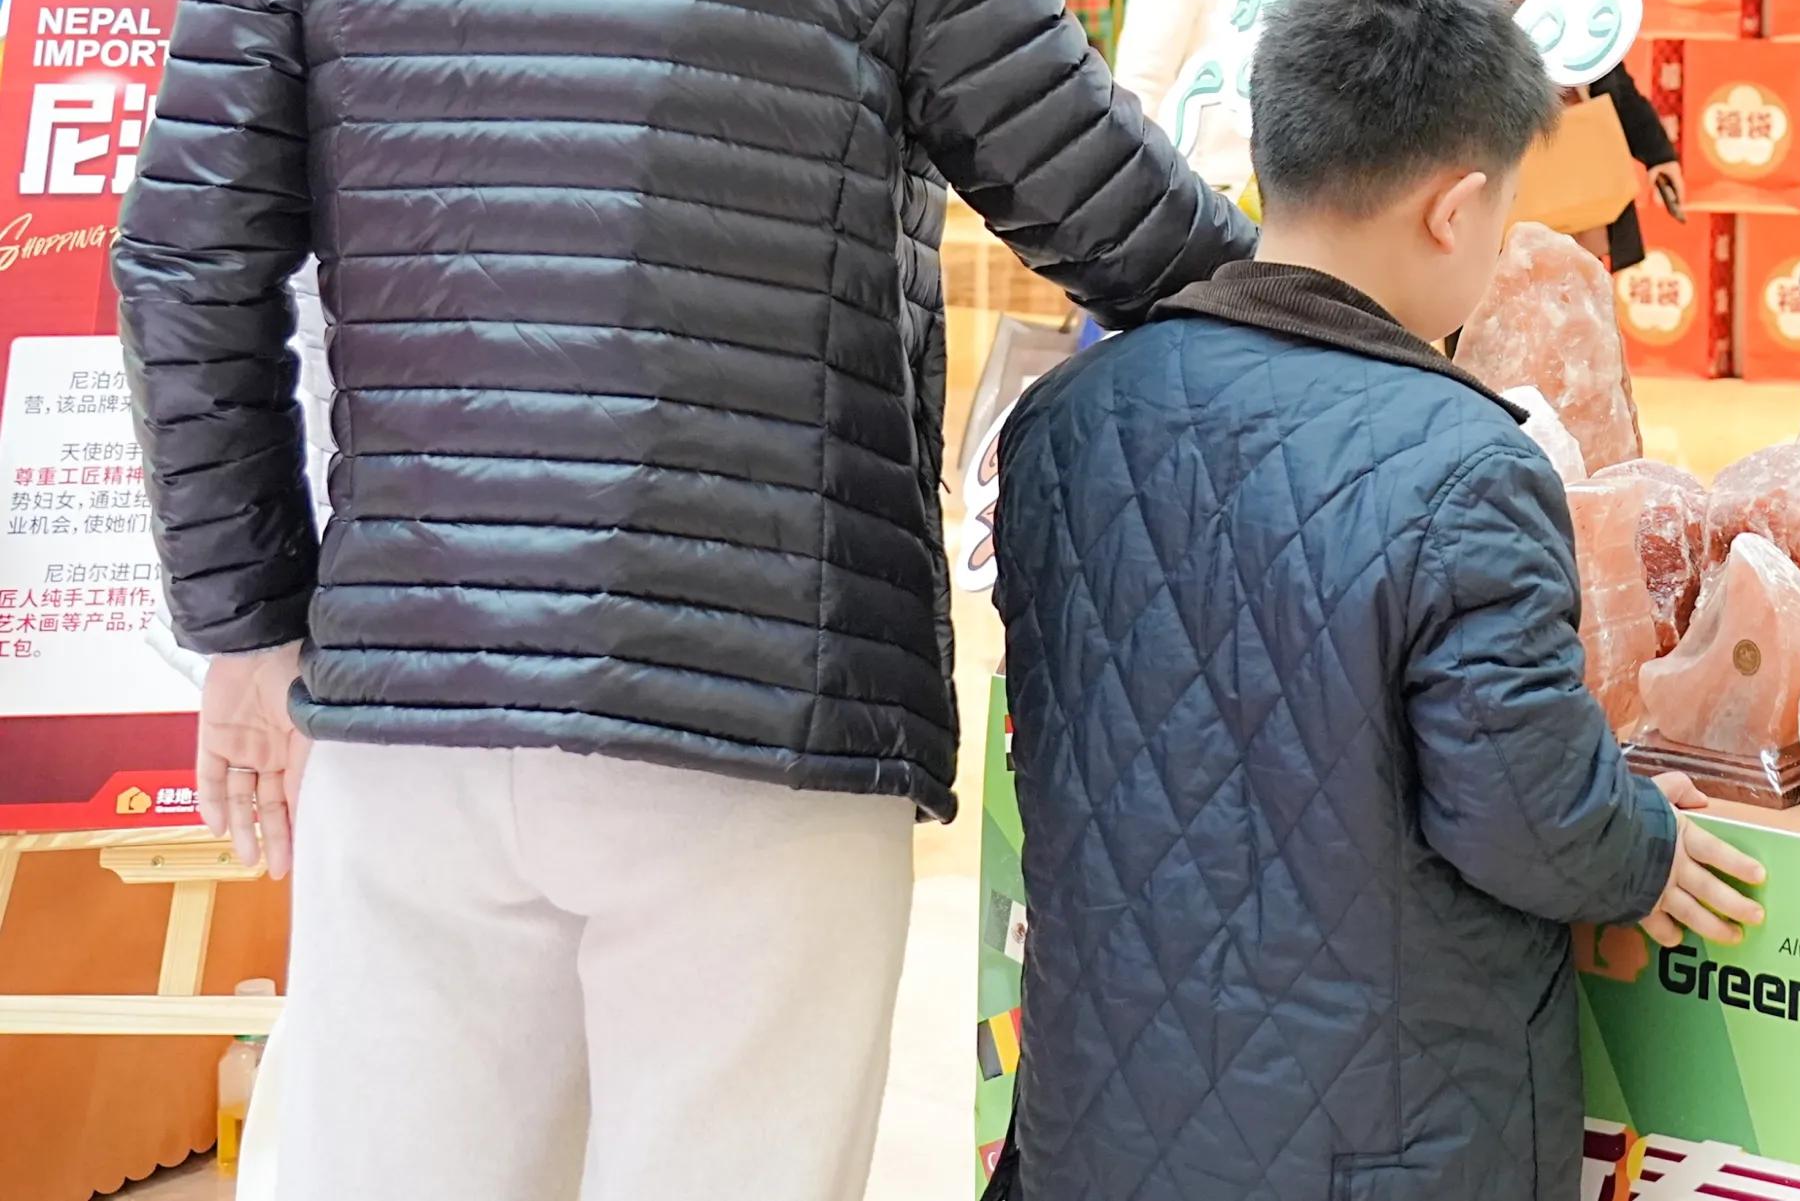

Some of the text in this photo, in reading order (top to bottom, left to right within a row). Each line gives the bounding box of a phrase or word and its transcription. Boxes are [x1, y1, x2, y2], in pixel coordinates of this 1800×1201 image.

[37, 7, 161, 35] NEPAL
[60, 442, 144, 462] 天使的手
[14, 465, 144, 487] 尊重工匠精神
[44, 562, 161, 584] 尼泊尔进口
